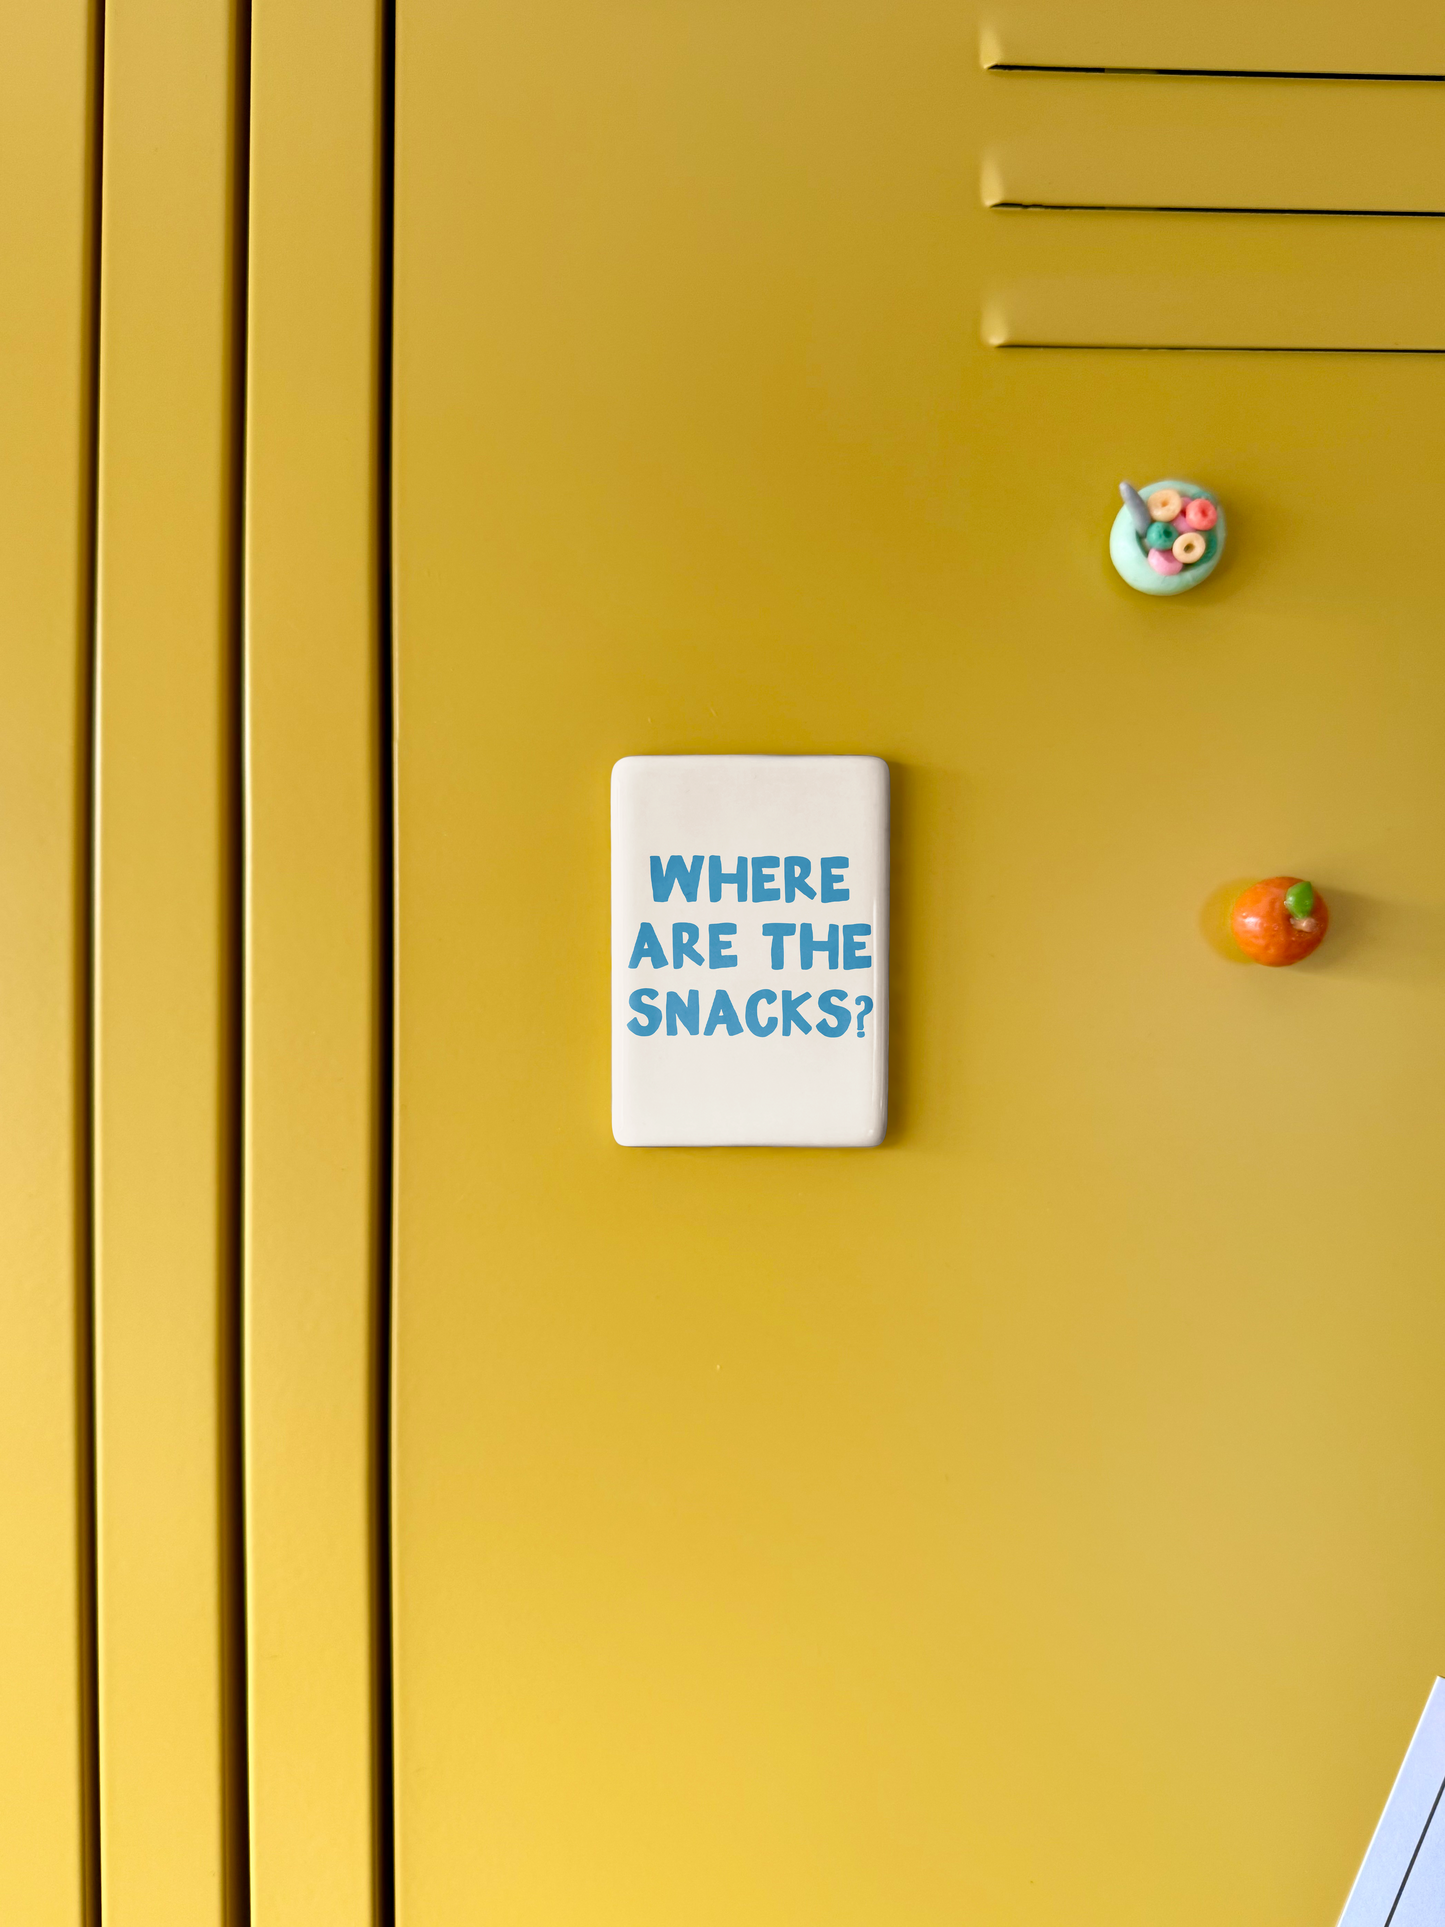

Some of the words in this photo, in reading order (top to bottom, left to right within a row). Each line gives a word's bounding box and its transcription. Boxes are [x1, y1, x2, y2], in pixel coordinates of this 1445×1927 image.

[650, 855, 850, 903] WHERE
[628, 922, 738, 970] ARE
[762, 922, 872, 970] THE
[626, 988, 874, 1038] SNACKS?
